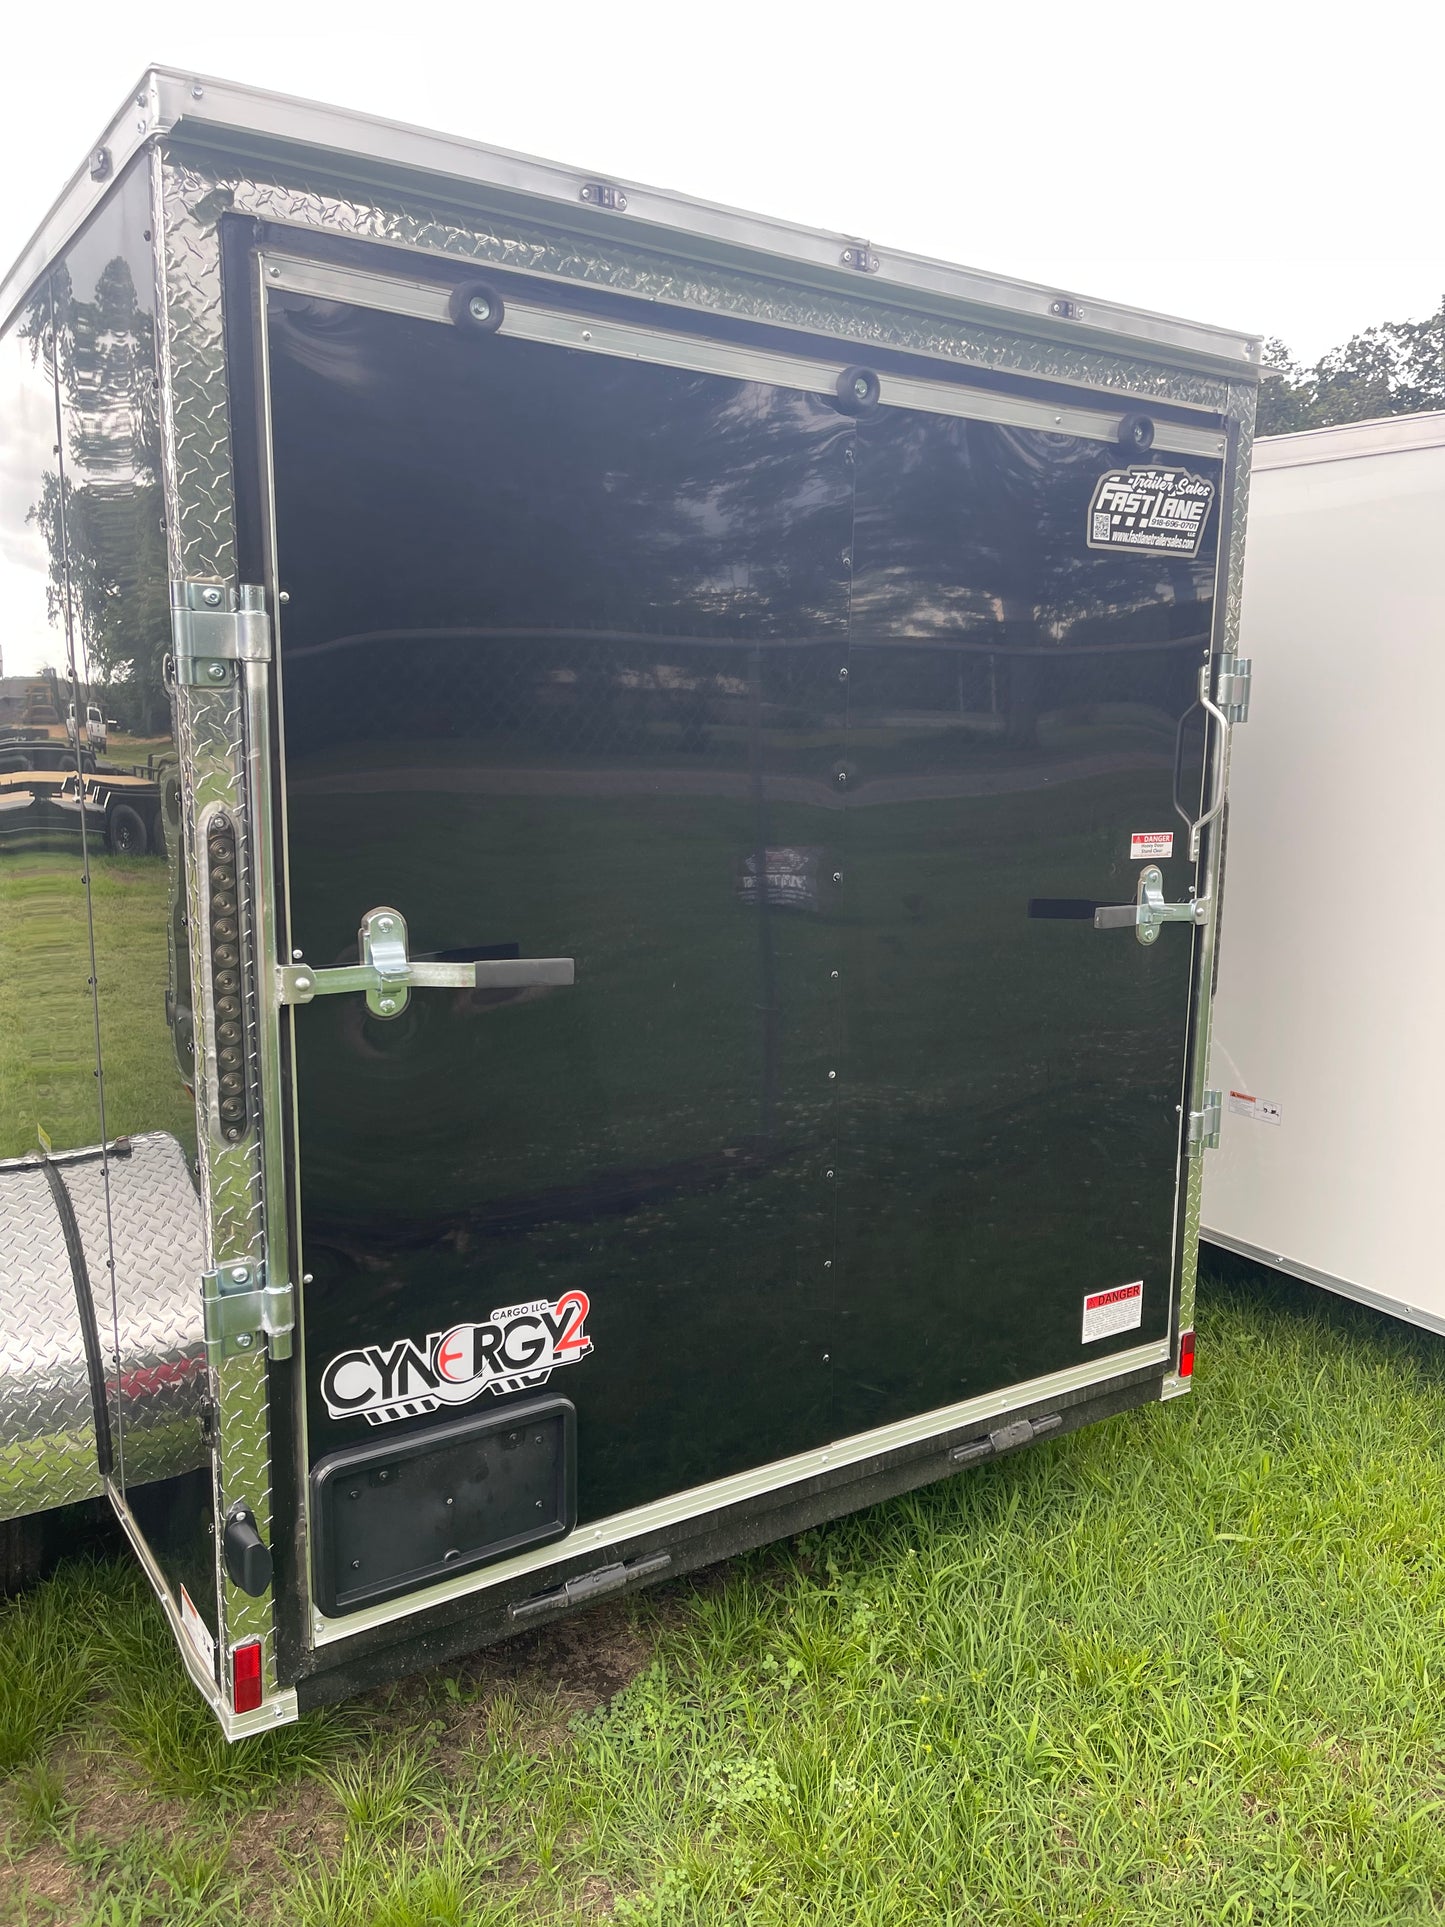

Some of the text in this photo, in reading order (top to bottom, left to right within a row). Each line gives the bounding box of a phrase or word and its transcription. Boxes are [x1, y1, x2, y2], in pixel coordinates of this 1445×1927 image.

[1131, 472, 1210, 496] Trailer Sales
[1096, 482, 1205, 521] FAST LANE
[1151, 518, 1197, 529] 918-696-0701
[1112, 530, 1194, 549] www.fastlanetrailersales.com
[1144, 835, 1170, 843] DANGER
[1098, 1286, 1140, 1306] DANGER
[492, 1302, 547, 1321] CARGO LLC
